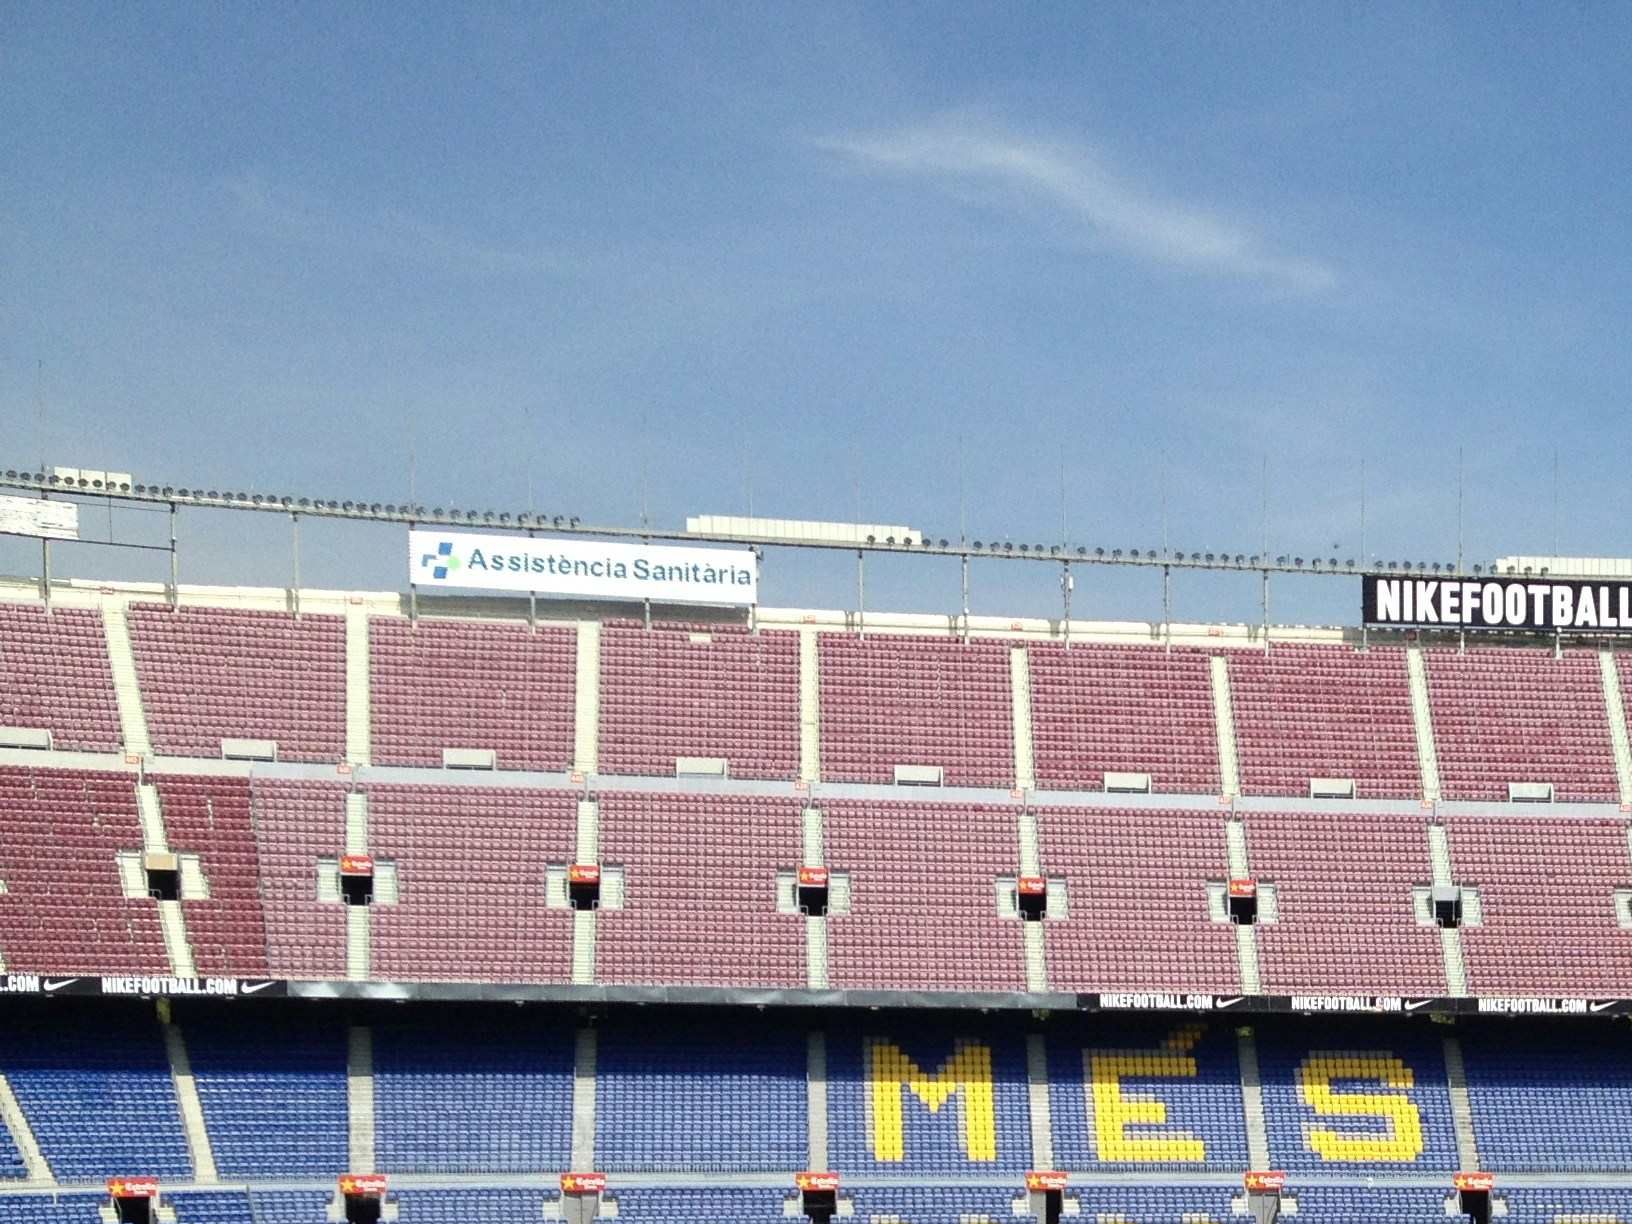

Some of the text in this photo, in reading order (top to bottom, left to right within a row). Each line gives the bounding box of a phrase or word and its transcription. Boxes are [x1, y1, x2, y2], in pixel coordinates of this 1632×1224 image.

[467, 547, 753, 588] Assistència Sanitària
[0, 976, 40, 992] .COM
[102, 978, 237, 994] NIKEFOOTBALL.COM
[1100, 994, 1213, 1010] NIKEFOOTBALL.COM
[1478, 999, 1587, 1013] NIKEFOOTBALL.COM
[868, 1024, 1426, 1162] MÉS
